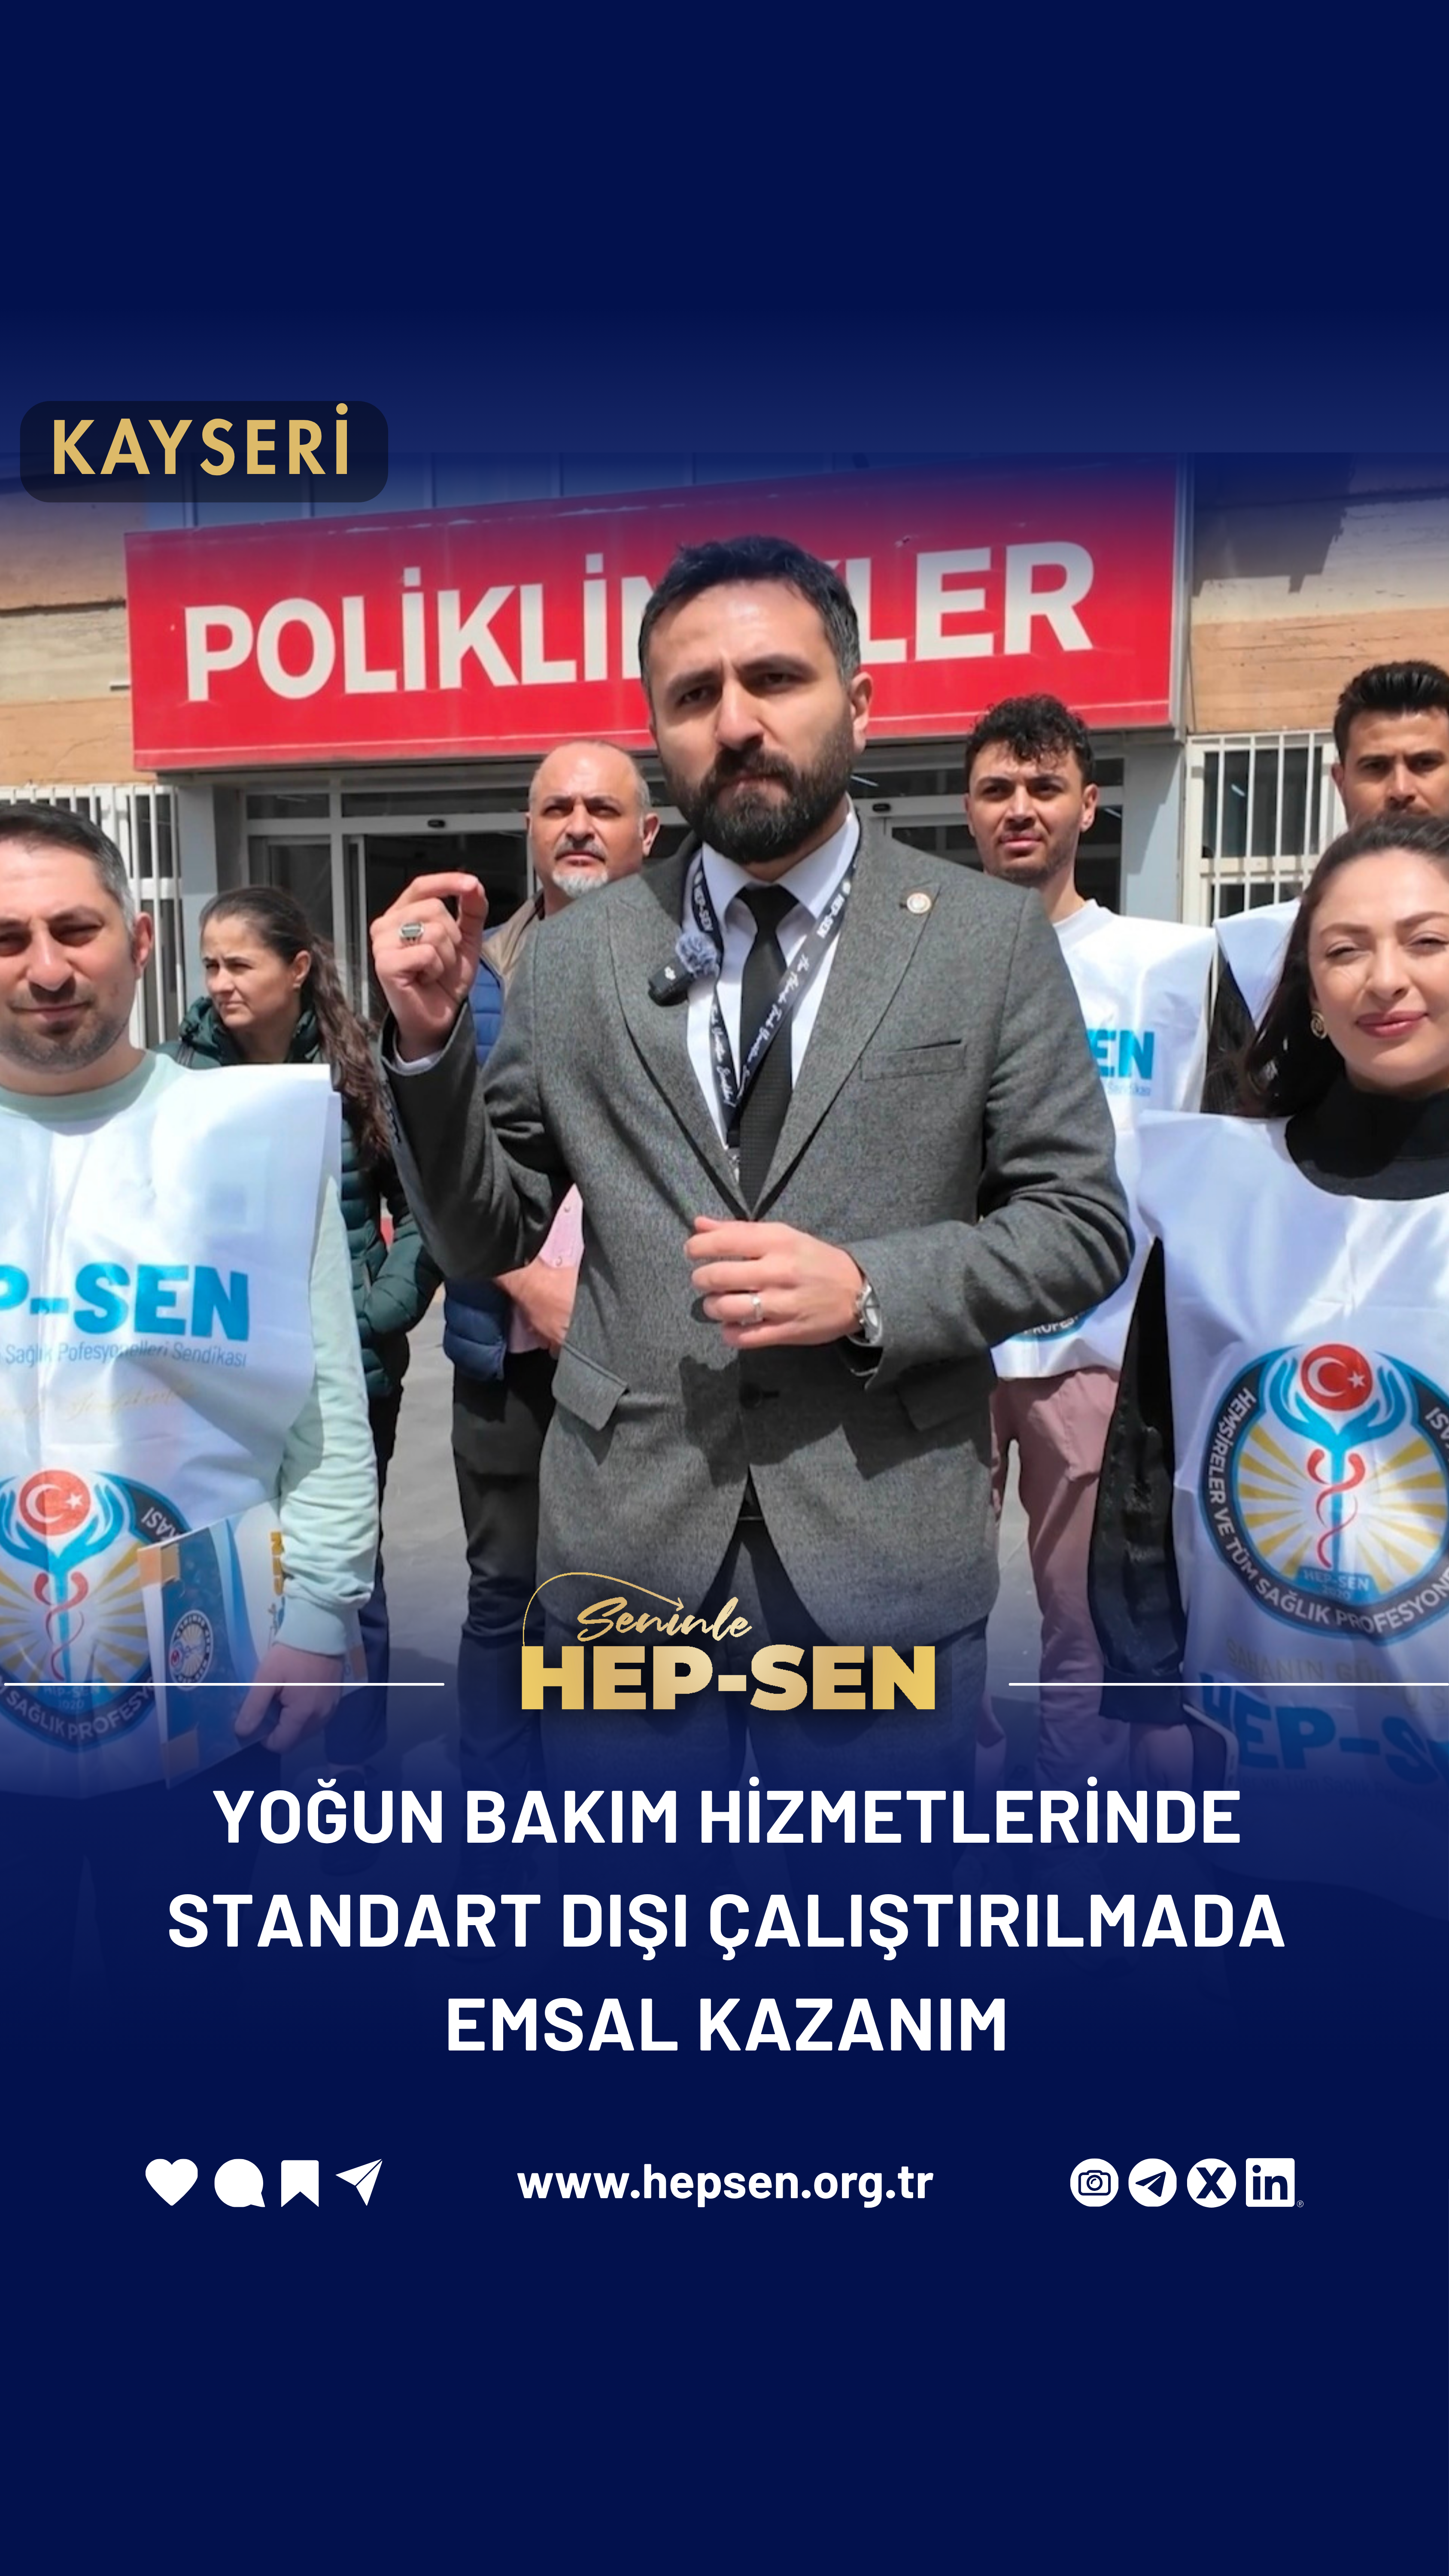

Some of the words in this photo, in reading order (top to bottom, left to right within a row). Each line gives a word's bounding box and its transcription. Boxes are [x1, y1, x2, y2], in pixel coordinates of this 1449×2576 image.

[185, 542, 1093, 702] POLİKLİLER
[172, 1342, 247, 1368] Sendikası
[1208, 1387, 1257, 1504] HEMŞİRELER
[1214, 1507, 1236, 1537] VE
[1226, 1537, 1259, 1580] TÜM
[1255, 1577, 1331, 1625] SAĞLIK
[6, 1690, 66, 1738] SAĞLIK
